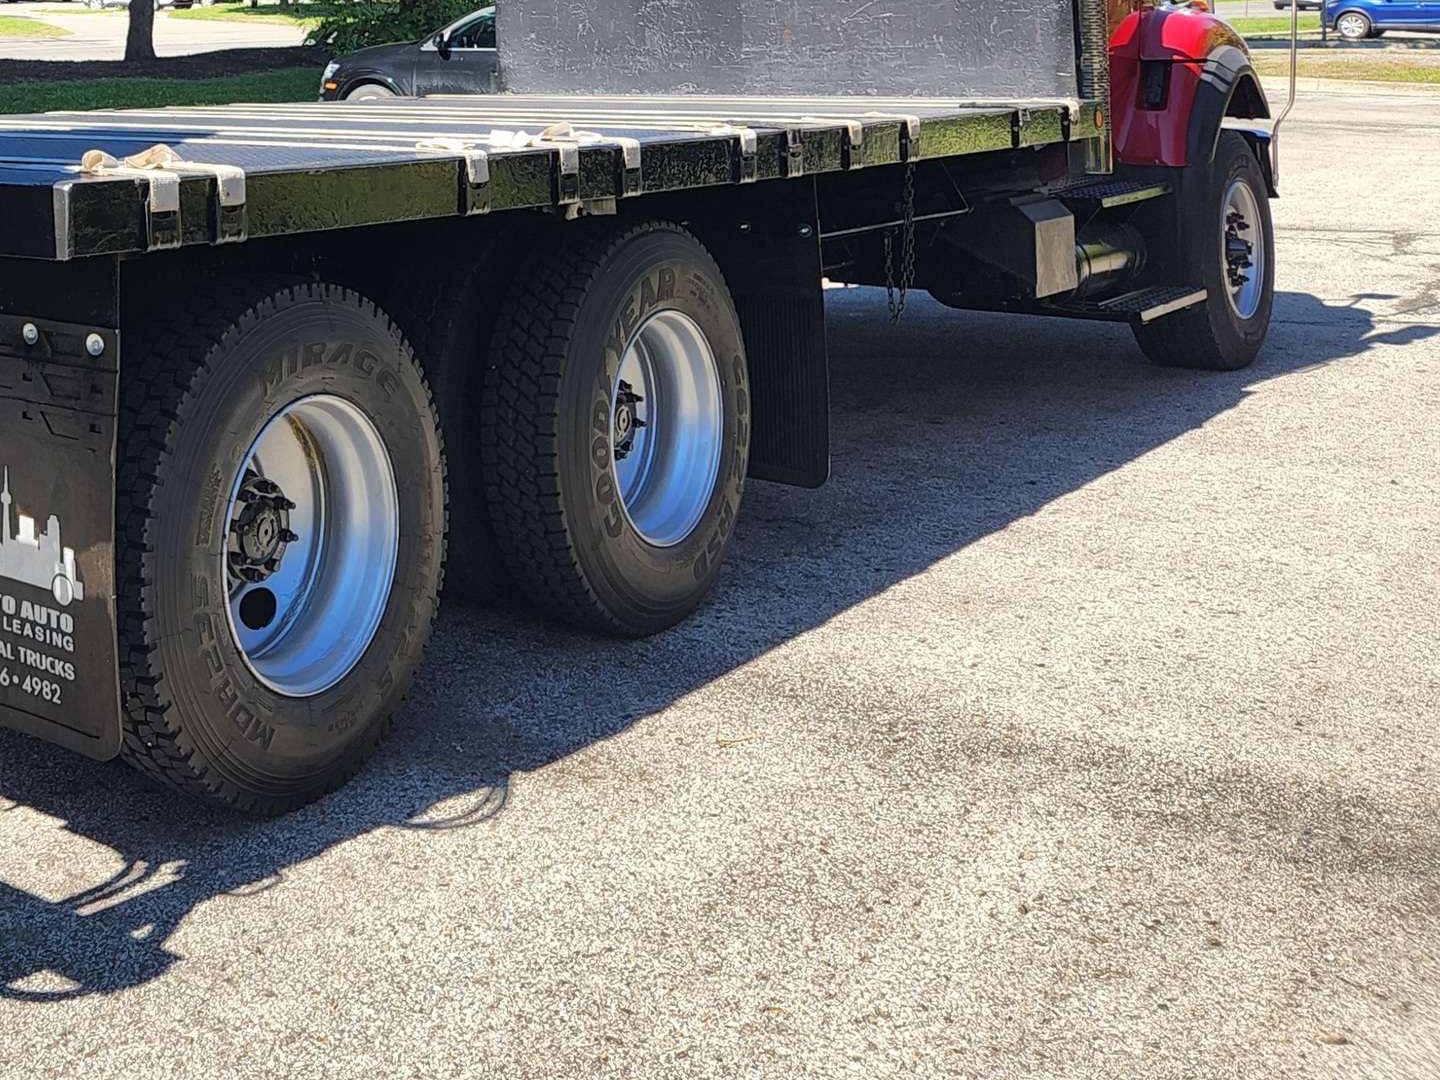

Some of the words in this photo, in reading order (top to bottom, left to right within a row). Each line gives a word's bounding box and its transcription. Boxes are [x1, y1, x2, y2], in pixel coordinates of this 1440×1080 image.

[260, 342, 402, 400] MIRAGE
[592, 267, 675, 538] GOODYEAR
[3, 615, 75, 652] LEASING
[20, 599, 74, 634] AUTO
[18, 645, 76, 681] TRUCKS
